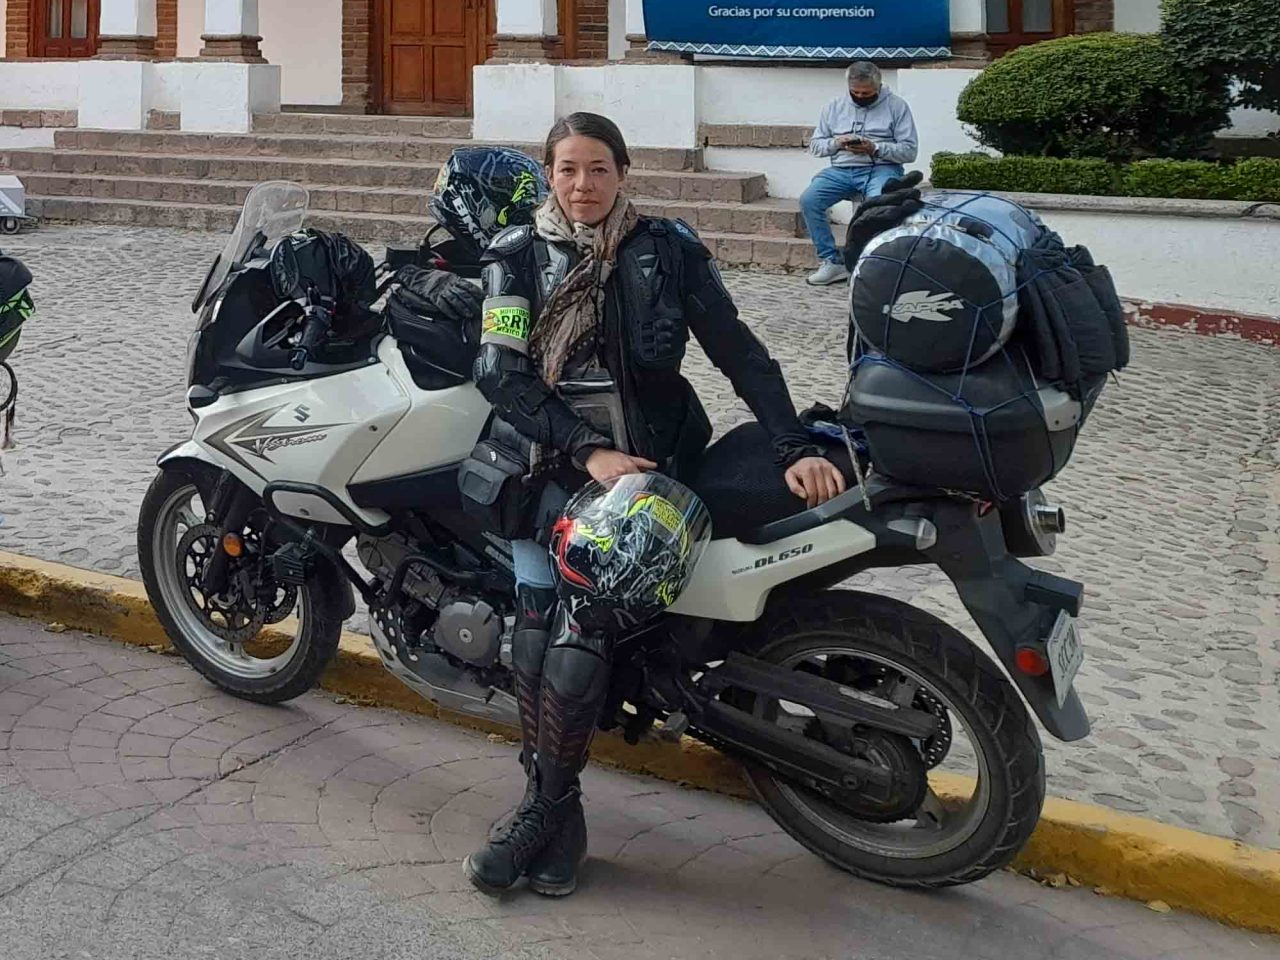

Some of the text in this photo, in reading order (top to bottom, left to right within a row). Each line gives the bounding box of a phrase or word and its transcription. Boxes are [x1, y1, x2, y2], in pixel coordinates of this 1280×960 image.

[709, 5, 874, 19] Gracias por su comprensión
[755, 543, 814, 569] DL650
